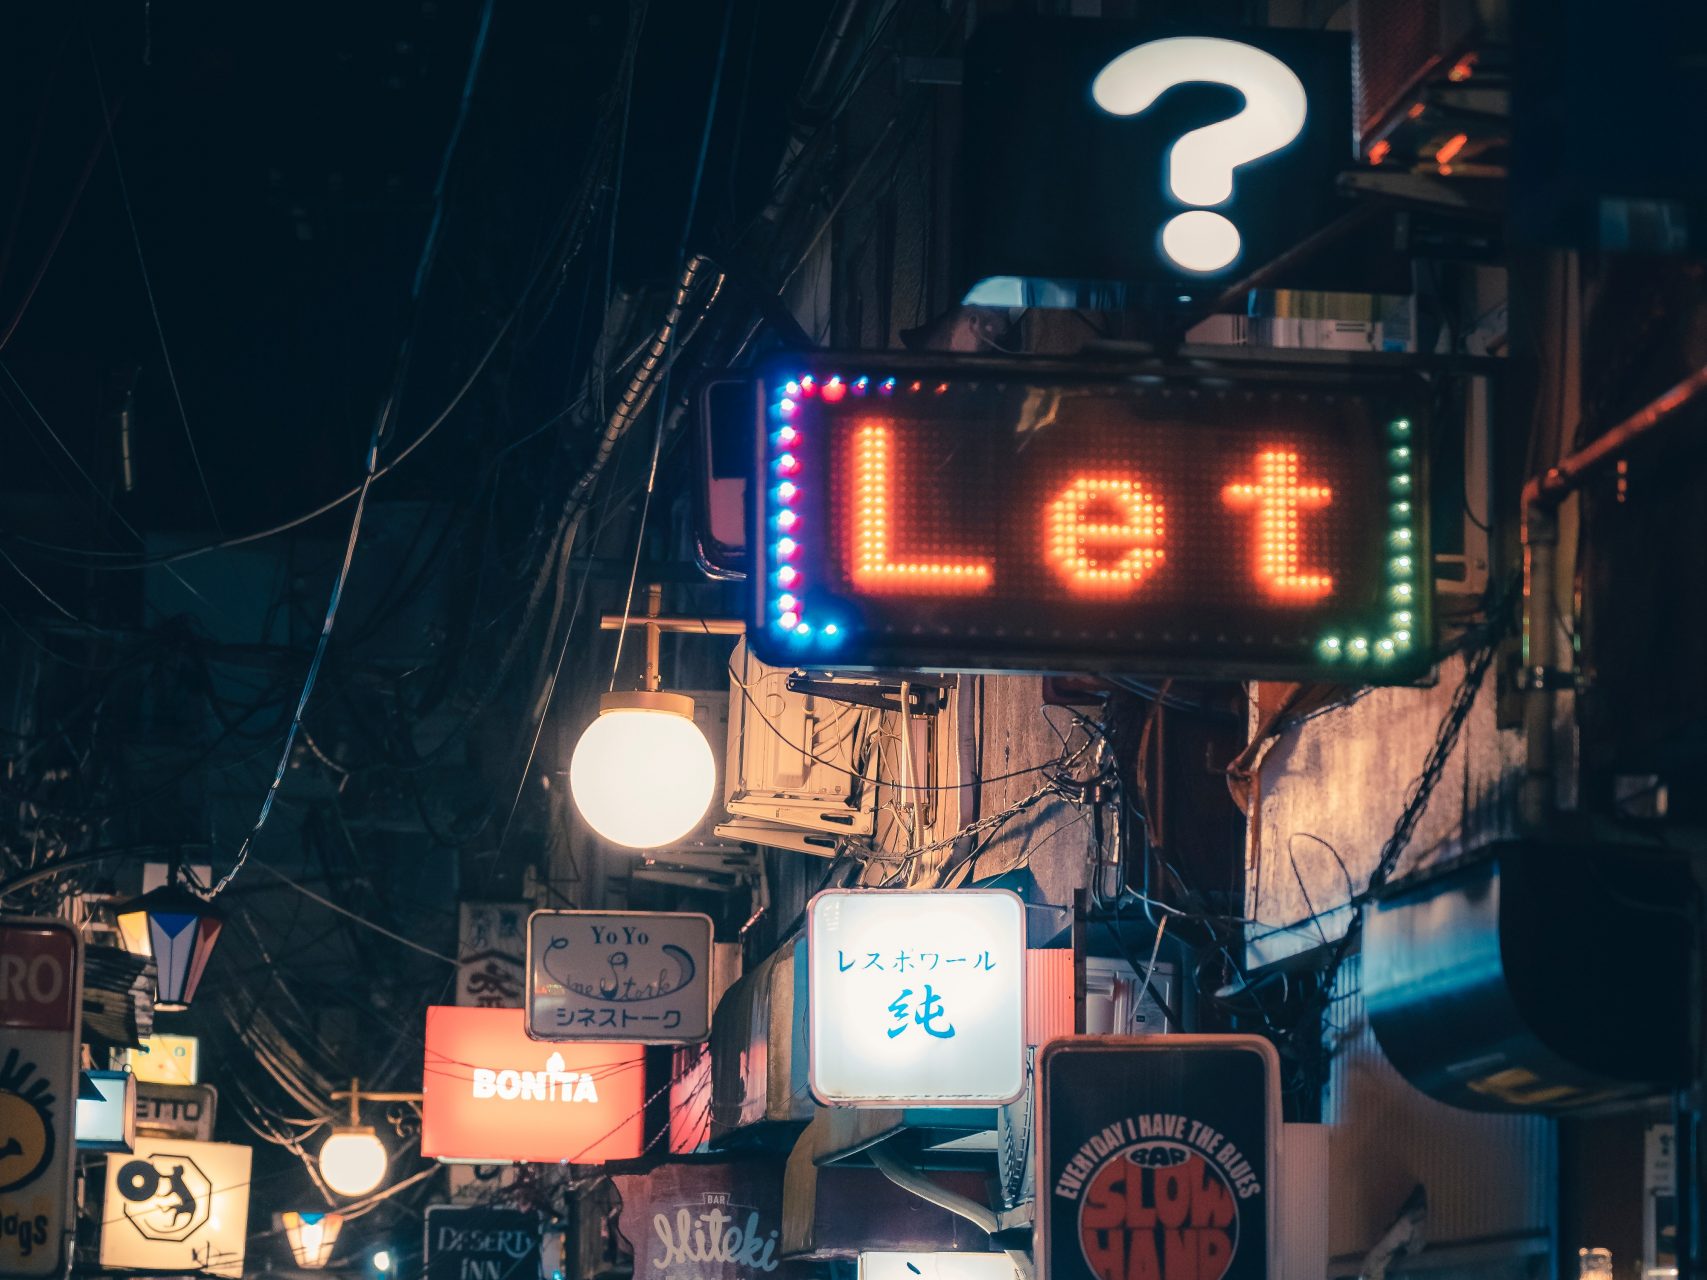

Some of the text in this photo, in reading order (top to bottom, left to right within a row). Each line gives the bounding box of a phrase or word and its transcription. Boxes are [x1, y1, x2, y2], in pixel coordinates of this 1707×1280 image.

[854, 422, 1336, 597] Let
[556, 1008, 681, 1029] シネストーク
[887, 984, 956, 1039] 純
[472, 1052, 599, 1104] BONITA
[1055, 1113, 1261, 1200] EVERYDAY I HAVE THE BLUES
[1129, 1146, 1188, 1168] BAR
[706, 1194, 726, 1205] BAR
[1082, 1154, 1235, 1229] SLOW
[653, 1208, 779, 1272] Miteki
